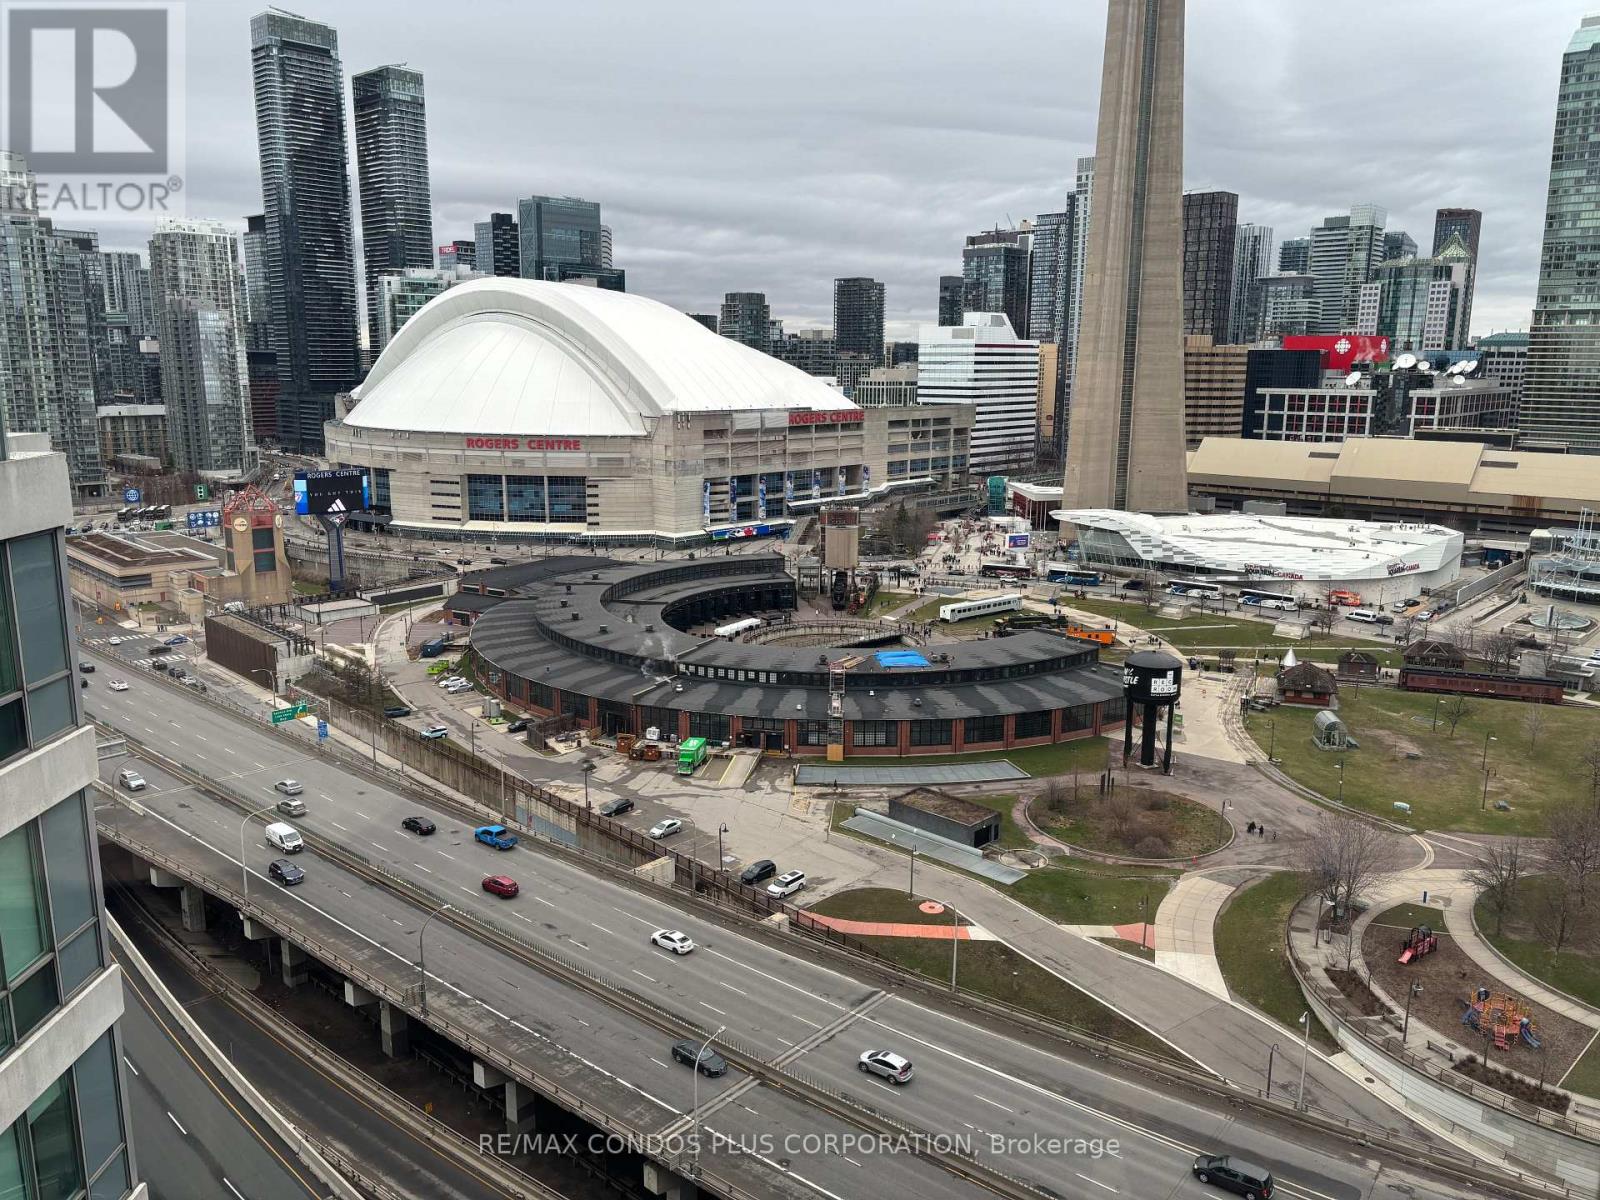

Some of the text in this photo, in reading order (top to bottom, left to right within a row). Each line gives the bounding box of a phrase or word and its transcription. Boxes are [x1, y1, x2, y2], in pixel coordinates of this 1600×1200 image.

[789, 411, 865, 425] ROGERS CENTRE
[466, 437, 581, 450] ROGERS CENTRE
